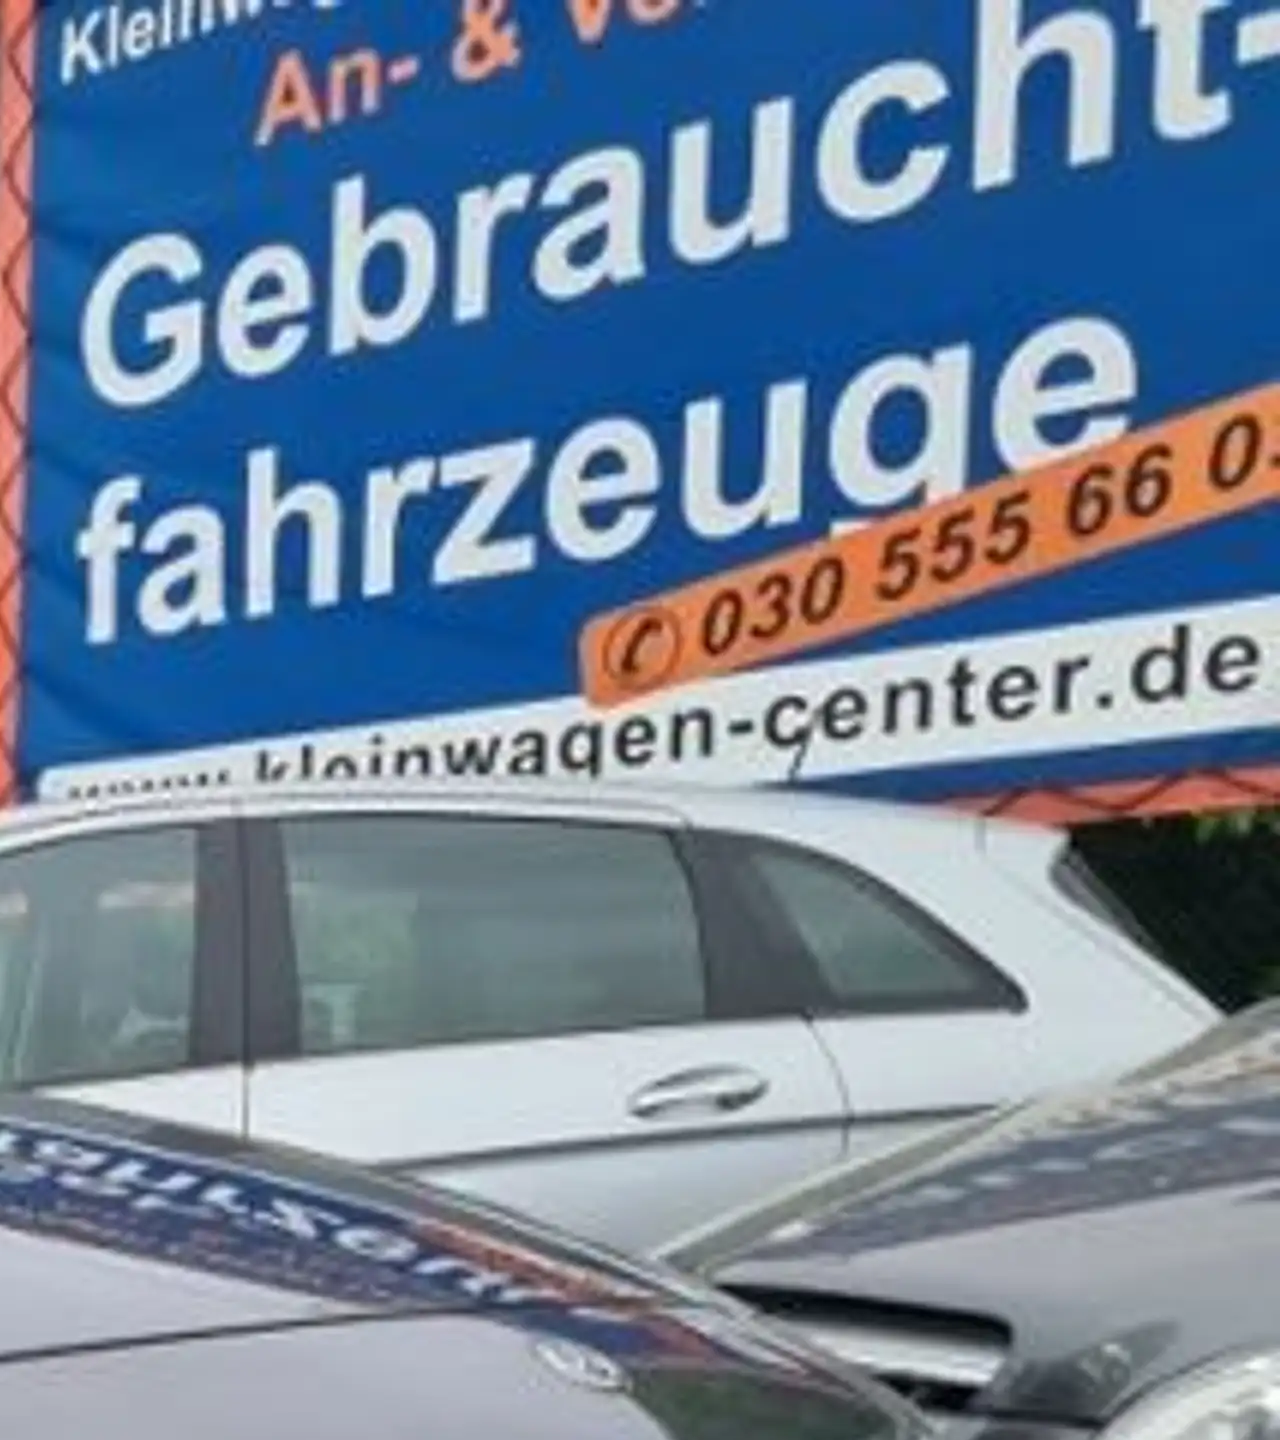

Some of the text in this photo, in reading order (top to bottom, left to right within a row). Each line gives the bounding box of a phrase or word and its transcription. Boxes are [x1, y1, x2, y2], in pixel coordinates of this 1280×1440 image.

[253, 49, 420, 148] An-
[451, 0, 520, 81] &
[75, 313, 1138, 645] fahrzeuge
[700, 412, 1280, 658] 030 555 66 0
